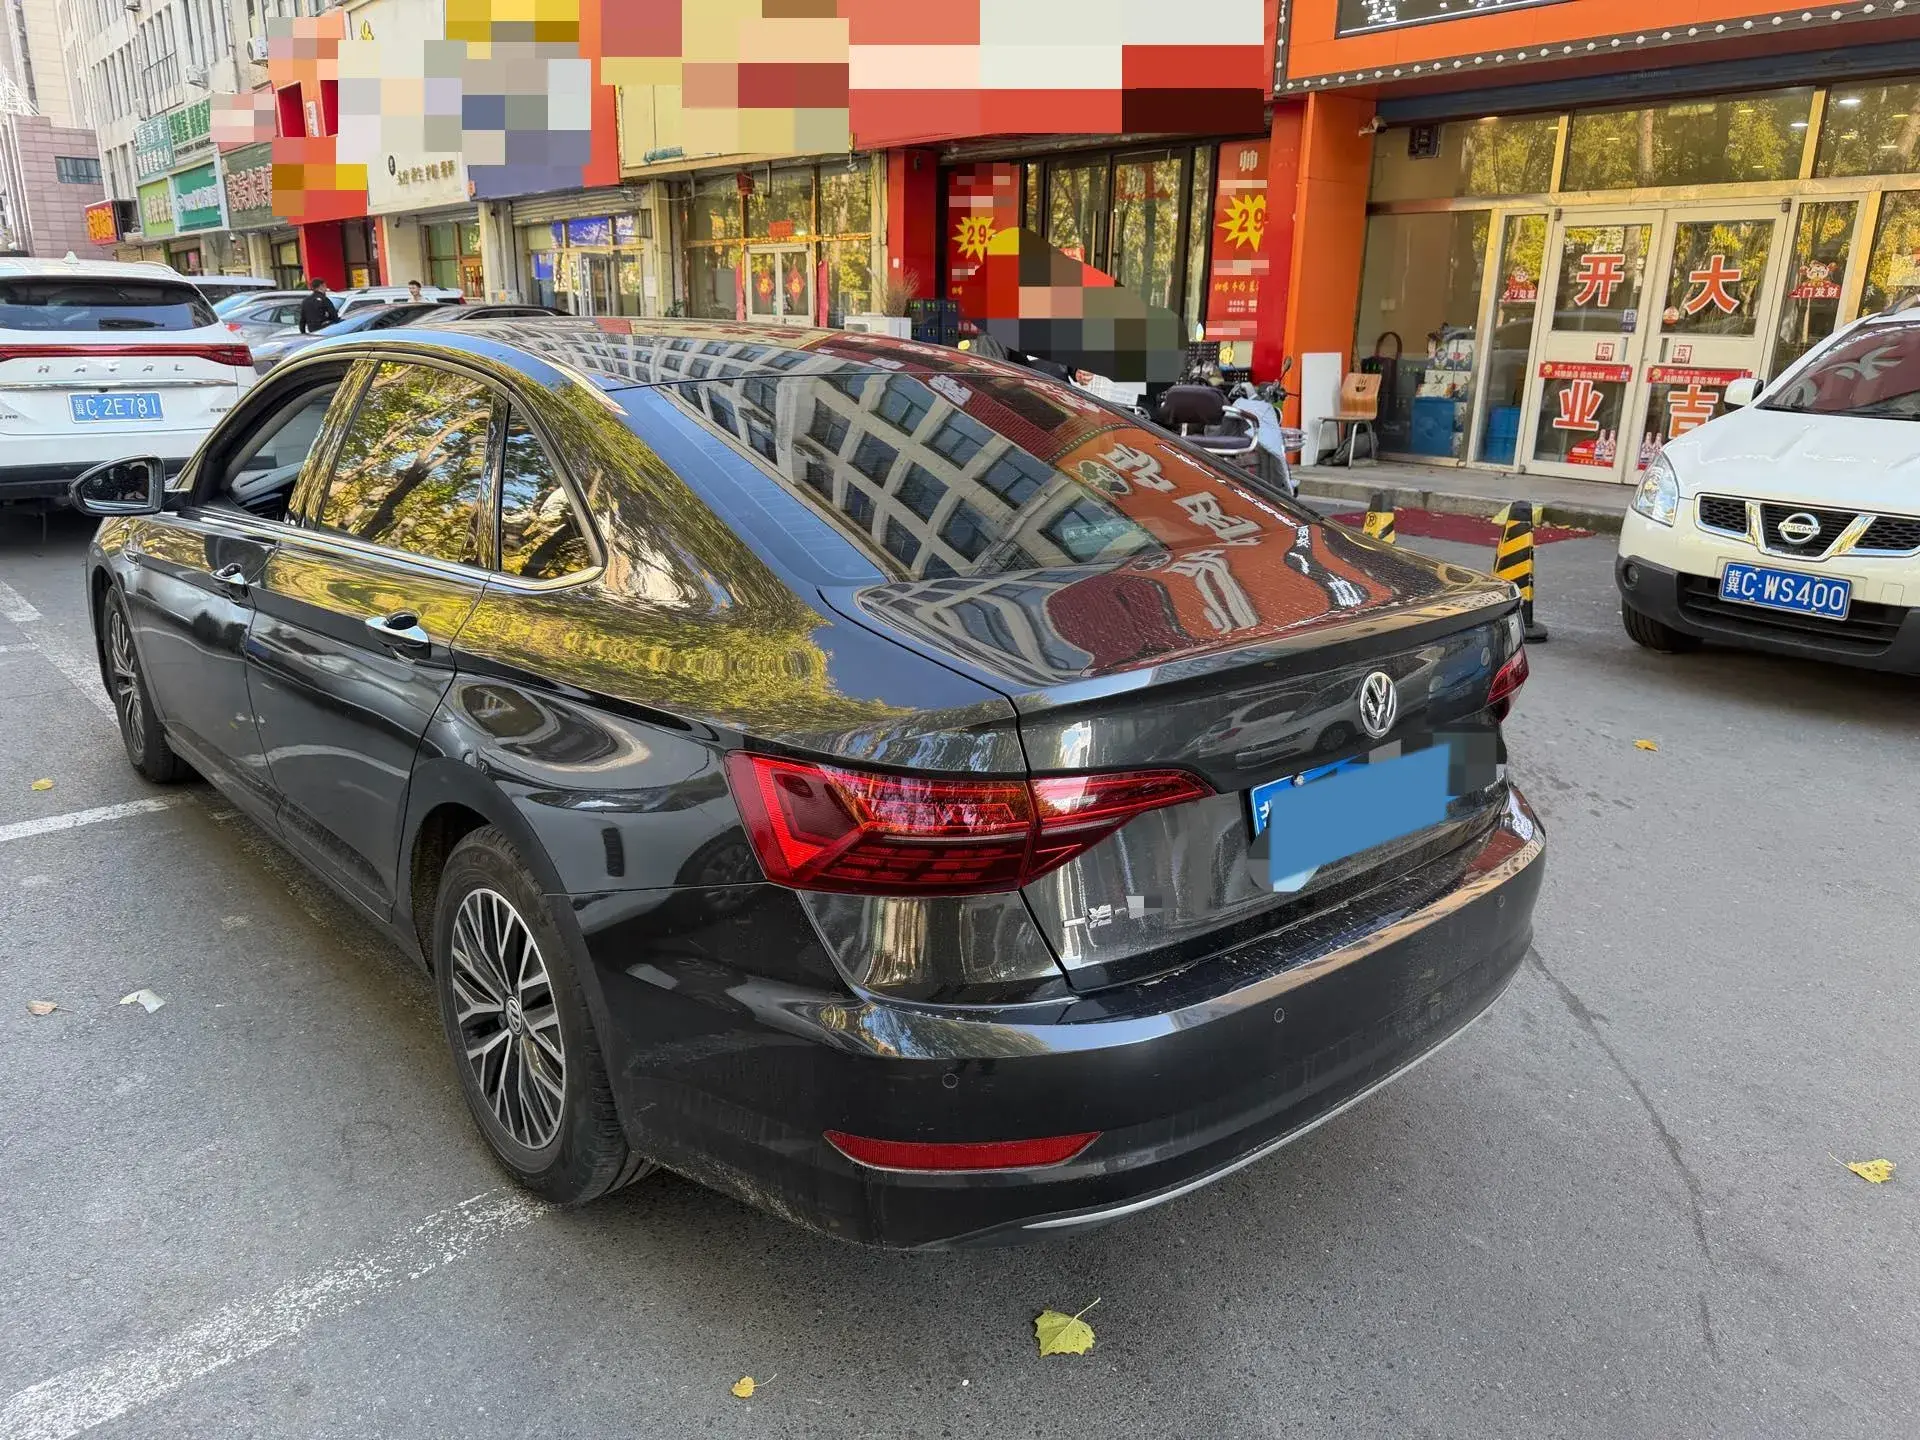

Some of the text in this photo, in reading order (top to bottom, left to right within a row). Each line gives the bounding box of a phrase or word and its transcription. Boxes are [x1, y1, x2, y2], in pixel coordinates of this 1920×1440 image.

[1239, 150, 1258, 171] 帅
[1574, 254, 1625, 307] 开
[1685, 255, 1742, 315] 大
[37, 363, 184, 374] HAVAL
[1553, 380, 1604, 431] 业
[1668, 384, 1719, 440] 吉
